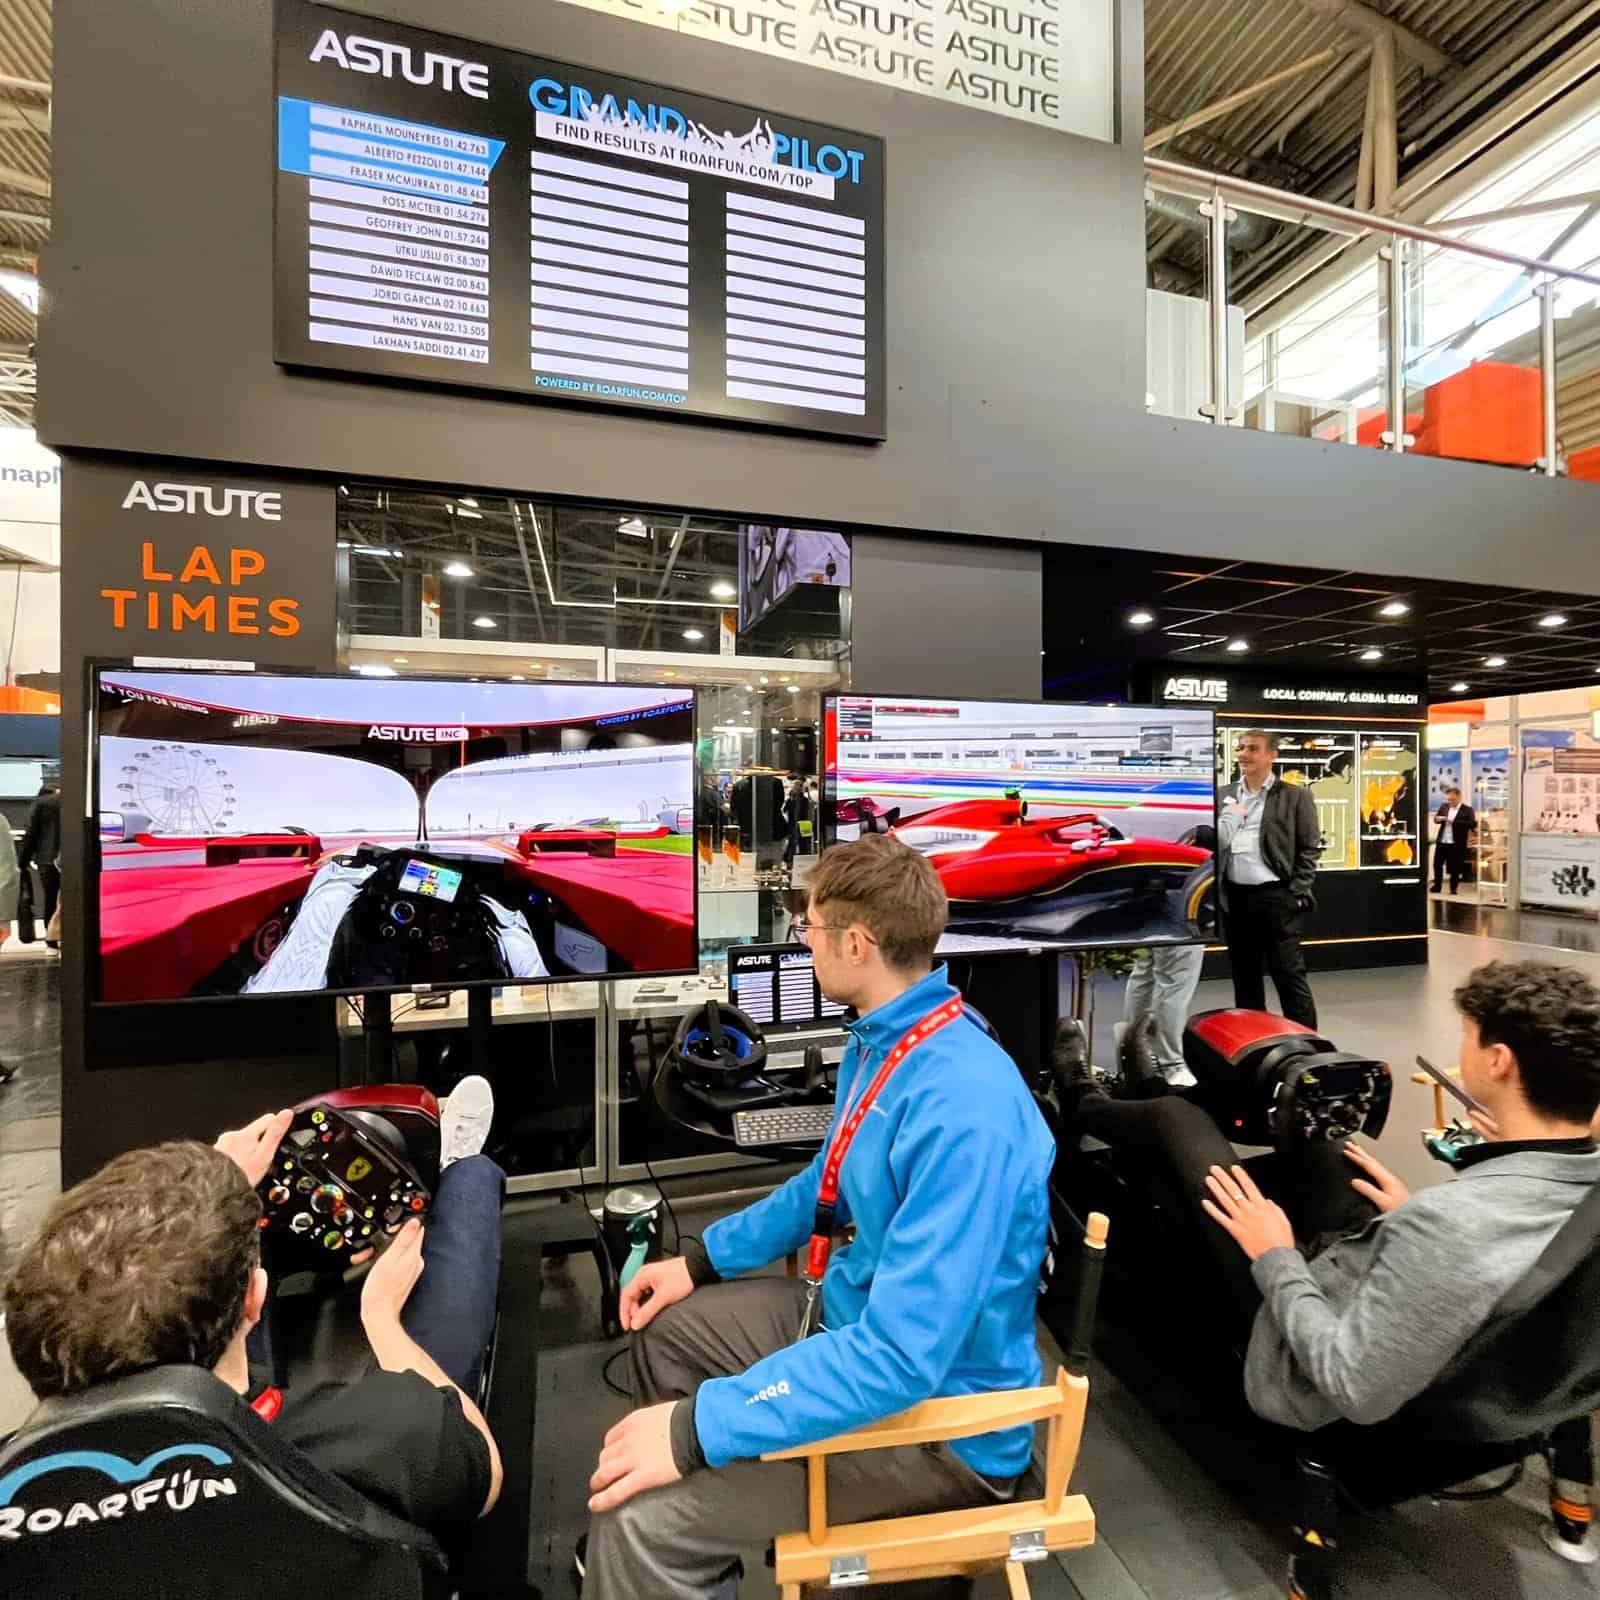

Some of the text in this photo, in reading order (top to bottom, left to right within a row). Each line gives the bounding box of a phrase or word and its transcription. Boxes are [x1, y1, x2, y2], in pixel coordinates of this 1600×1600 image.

[945, 0, 1059, 47] ASTUTE
[309, 29, 489, 99] ASTUTE
[657, 0, 1059, 119] STUTE ASTUTE ASTUTE
[945, 31, 1059, 83] ASTUTE
[340, 117, 383, 134] RAPHAEL
[528, 78, 865, 184] GRAND PILOT
[364, 144, 404, 161] ALBERTO
[555, 121, 814, 190] FIND RESULTS AT ROARFUN.COM/TOP
[350, 166, 384, 181] FRASER
[386, 173, 442, 191] MCMURRAY
[382, 196, 406, 208] ROSS
[366, 216, 413, 232] GEOFFREY
[416, 224, 441, 237] JOHN
[395, 245, 418, 257] UTKU
[370, 264, 403, 278] DAWID
[405, 270, 441, 284] TECLAW
[373, 288, 401, 301] JORDI
[403, 293, 441, 306] GARCIA
[392, 314, 418, 327] HANS
[421, 319, 441, 330] VAN
[373, 335, 411, 349] LAKHAN
[413, 341, 442, 353] SADDI
[535, 375, 687, 404] POWERED BY ROARFUN.COM/TOP
[121, 480, 281, 521] ASTUTE
[142, 542, 265, 586] LAP
[101, 589, 300, 637] TIMES
[118, 688, 144, 701] YOU
[1164, 677, 1228, 698] ASTUTE
[1263, 688, 1418, 704] LOCAL COMPANY, GLOBAL REACH
[368, 725, 434, 741] ASTUTE
[737, 954, 772, 967] ASTUTE
